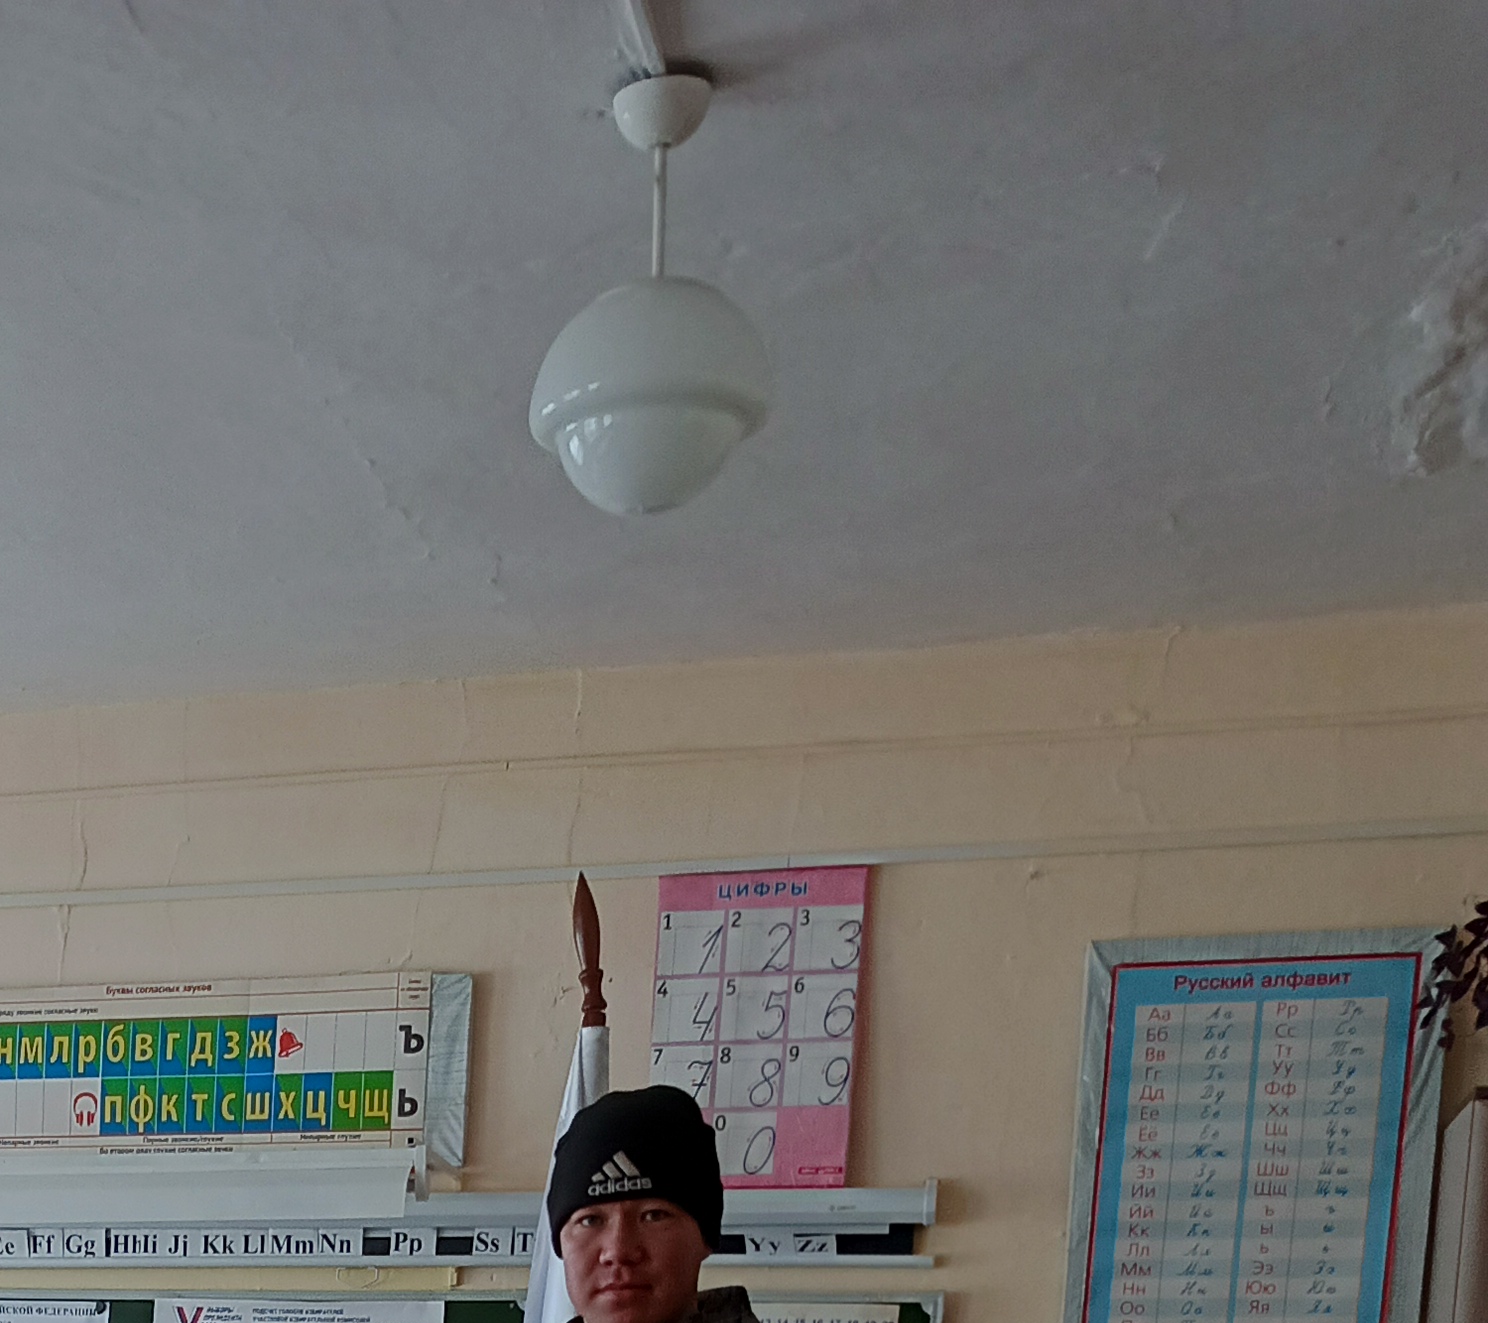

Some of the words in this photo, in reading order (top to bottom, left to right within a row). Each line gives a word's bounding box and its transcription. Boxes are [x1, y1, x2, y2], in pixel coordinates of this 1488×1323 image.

[718, 882, 807, 900] ЦИФРЫ
[663, 914, 672, 929] 1
[699, 925, 723, 974] 1
[732, 912, 741, 927] 2
[762, 923, 791, 972] 2
[800, 910, 810, 925] 3
[831, 921, 861, 969] 3
[106, 985, 133, 995] Буквы
[136, 985, 181, 994] согласных
[183, 983, 212, 992] звуков
[1174, 973, 1253, 994] Русский
[1262, 971, 1351, 990] алфавит
[658, 981, 668, 996] 4
[693, 993, 718, 1040] 4
[726, 980, 736, 995] 5
[757, 991, 787, 1039] 5
[795, 978, 805, 993] 6
[824, 988, 855, 1037] 6
[1148, 1008, 1170, 1021] Аа
[1277, 1002, 1298, 1019] Рр
[1146, 1027, 1168, 1042] Бб
[1275, 1024, 1296, 1038] Сс
[20, 1036, 42, 1063] м
[50, 1036, 68, 1063] л
[78, 1036, 96, 1073] р
[107, 1024, 125, 1062] б
[135, 1035, 153, 1061] в
[166, 1034, 180, 1060] г
[191, 1032, 212, 1066] д
[224, 1032, 239, 1059] з
[249, 1030, 272, 1058] ж
[1146, 1048, 1165, 1061] Вв
[1275, 1044, 1293, 1056] Тт
[1146, 1067, 1161, 1081] Гг
[1273, 1061, 1294, 1078] Уу
[654, 1050, 663, 1065] 7
[688, 1060, 712, 1099] 7
[721, 1049, 731, 1063] 8
[749, 1059, 781, 1107] 8
[790, 1047, 799, 1061] 9
[818, 1057, 850, 1105] 9
[1139, 1085, 1164, 1101] Дд
[1265, 1081, 1296, 1097] Фф
[105, 1097, 122, 1122] п
[130, 1085, 153, 1133] ф
[162, 1095, 178, 1121] к
[192, 1094, 208, 1121] т
[222, 1093, 235, 1120] с
[246, 1093, 269, 1119] ш
[278, 1091, 296, 1119] х
[307, 1091, 326, 1125] ц
[338, 1090, 355, 1117] ч
[365, 1090, 388, 1124] щ
[1141, 1107, 1159, 1120] Ее
[1267, 1103, 1289, 1117] Хх
[1139, 1124, 1157, 1141] Ёё
[1265, 1123, 1288, 1137] Цц
[715, 1116, 726, 1130] 0
[743, 1126, 775, 1174] 0
[1265, 1144, 1286, 1156] Чч
[1131, 1147, 1161, 1159] Жж
[1136, 1166, 1154, 1178] Зз
[1257, 1163, 1289, 1176] Шш
[588, 1177, 652, 1196] adidas
[1132, 1185, 1156, 1197] Ии
[1254, 1182, 1287, 1197] Щщ
[1130, 1204, 1154, 1219] Йй
[1128, 1224, 1149, 1237] Кк
[32, 1235, 54, 1254] Ff
[66, 1235, 95, 1257] Gg
[168, 1235, 188, 1256] Jj
[203, 1235, 235, 1254] Kk
[271, 1235, 312, 1254] Mm
[320, 1233, 351, 1253] Nn
[394, 1233, 422, 1255] Pp
[475, 1232, 499, 1252] Ss
[748, 1236, 780, 1255] Yy
[797, 1239, 828, 1253] Zz
[1127, 1243, 1150, 1256] Лл
[1121, 1263, 1151, 1276] Мм
[1253, 1261, 1273, 1275] Ээ
[1123, 1283, 1145, 1295] Нн
[1246, 1281, 1276, 1294] Юю
[1120, 1302, 1144, 1315] Оо
[1249, 1301, 1269, 1314] Яя
